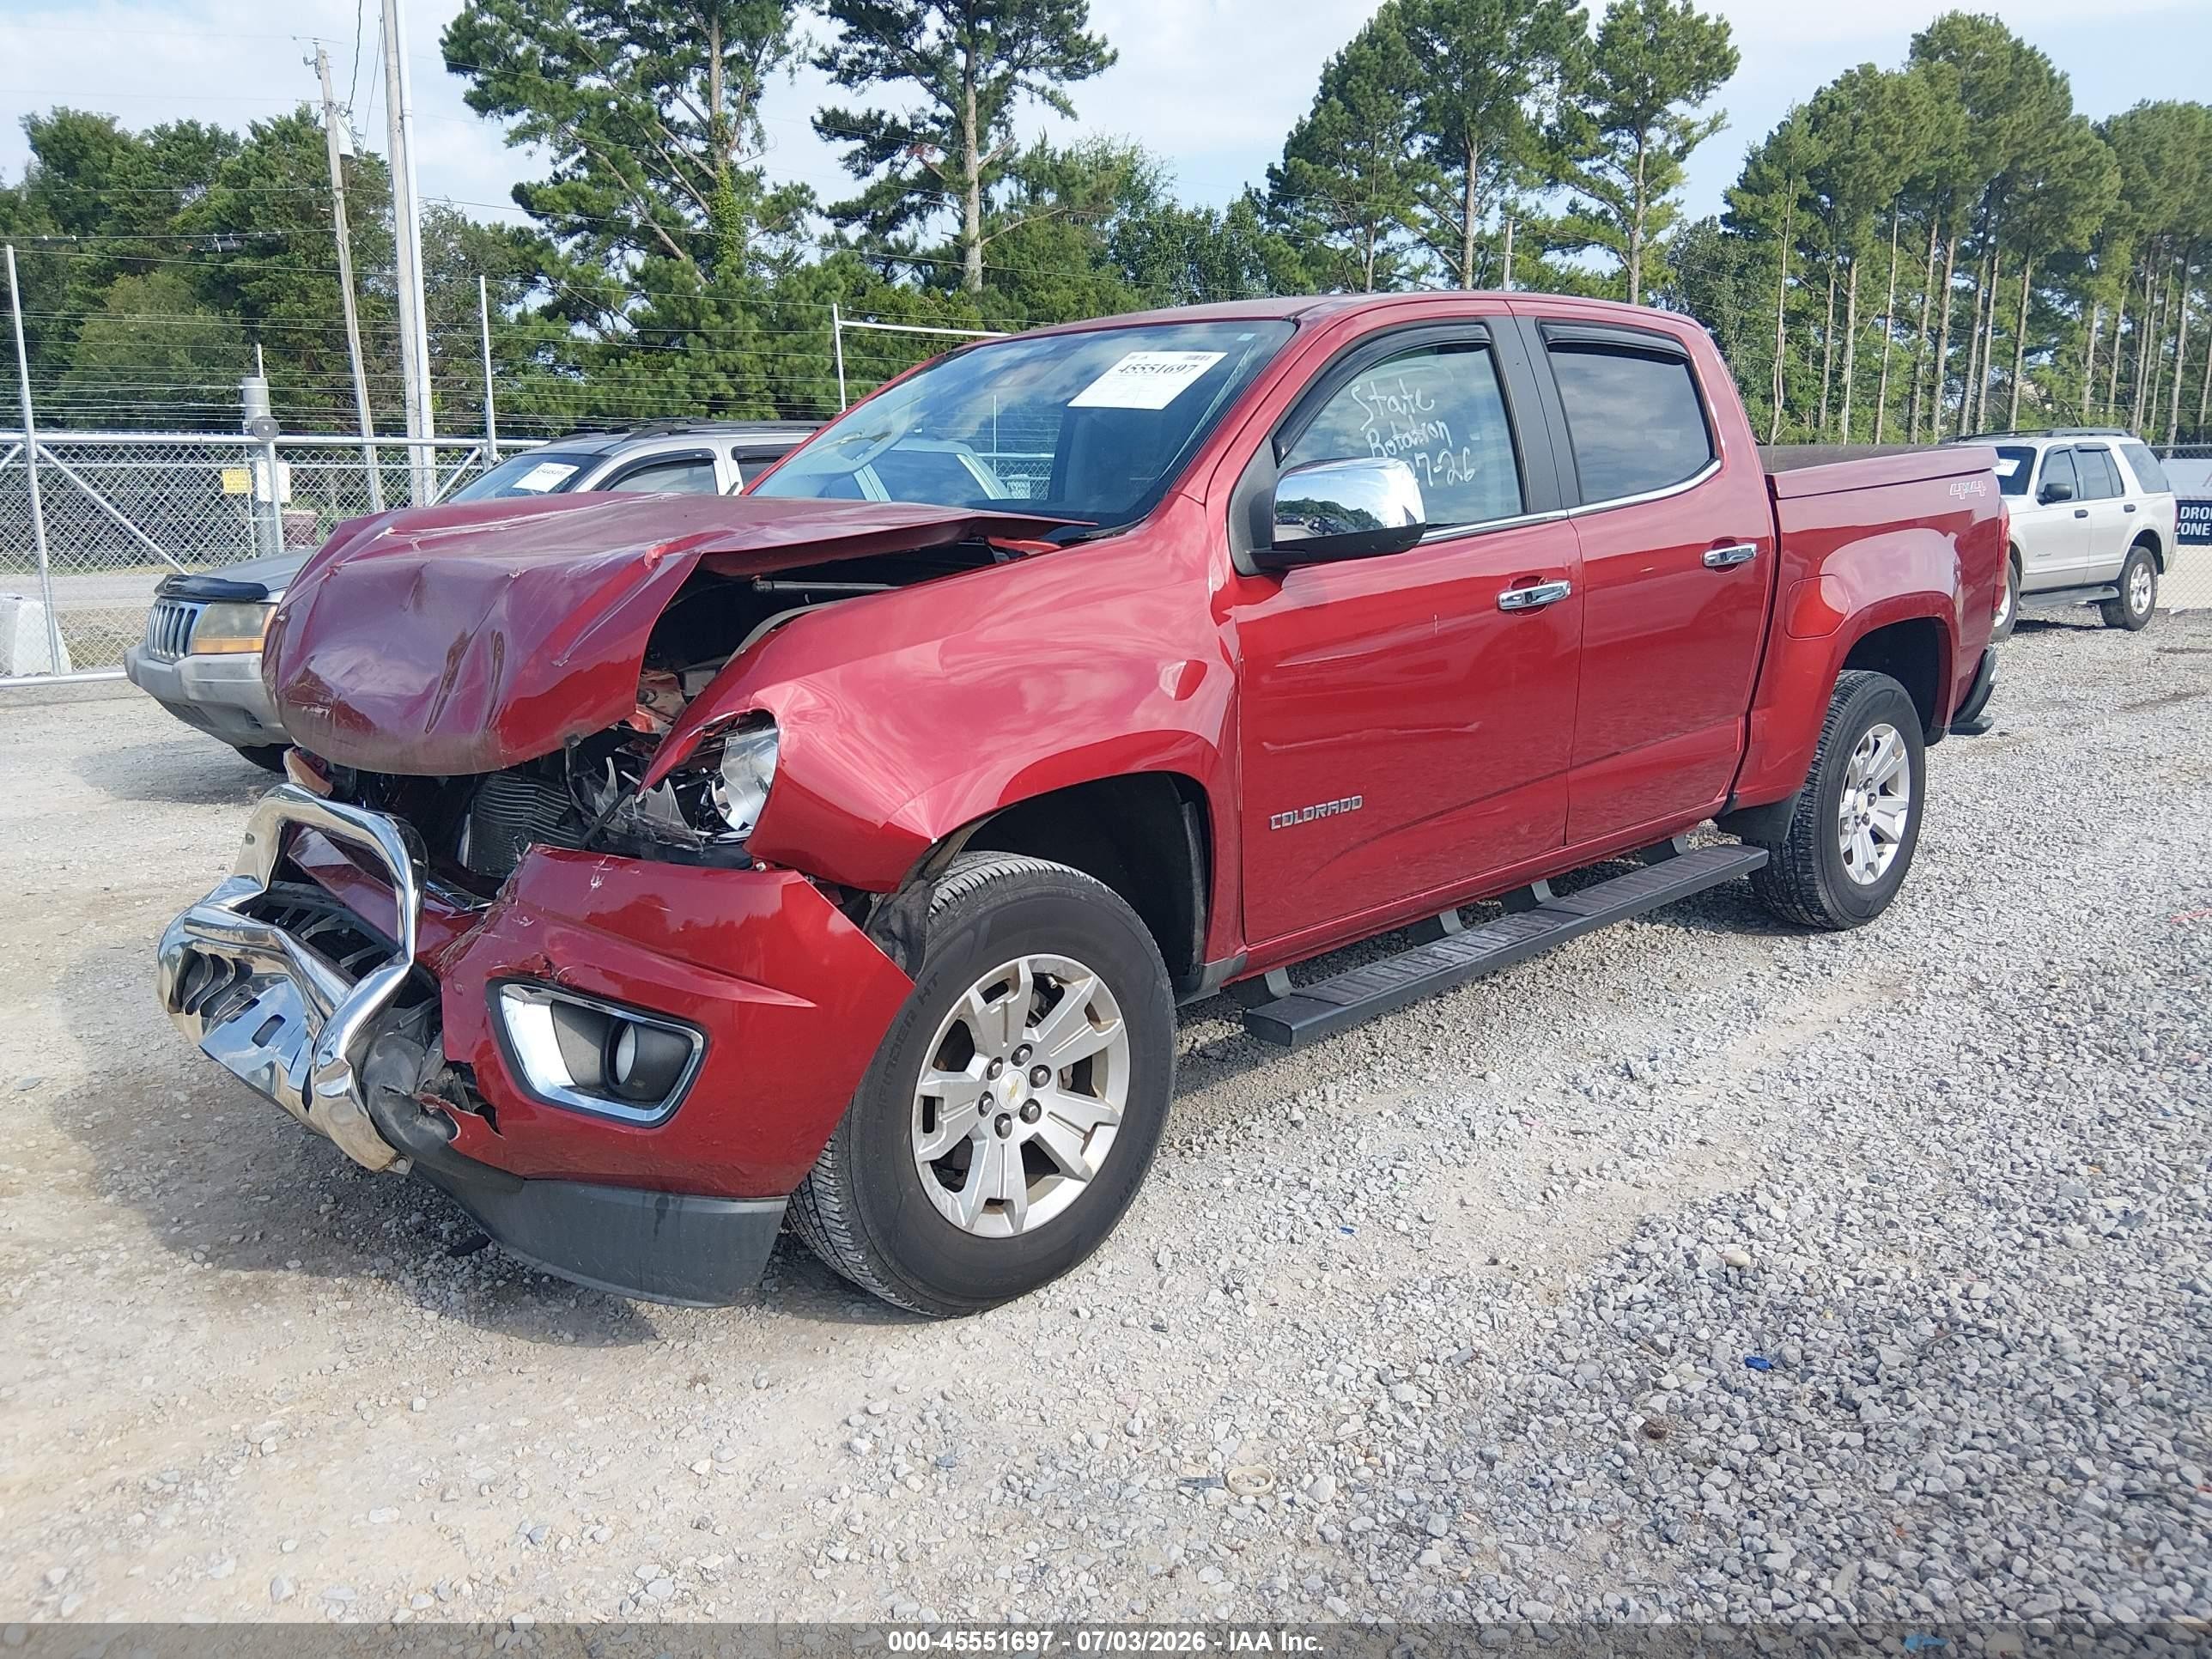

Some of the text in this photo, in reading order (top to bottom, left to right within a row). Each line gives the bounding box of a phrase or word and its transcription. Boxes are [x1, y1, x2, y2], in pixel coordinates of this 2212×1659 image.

[1118, 363, 1200, 374] 45551697
[1351, 378, 1436, 431] State
[2179, 506, 2212, 520] DRO
[1270, 794, 1364, 830] COLORADO
